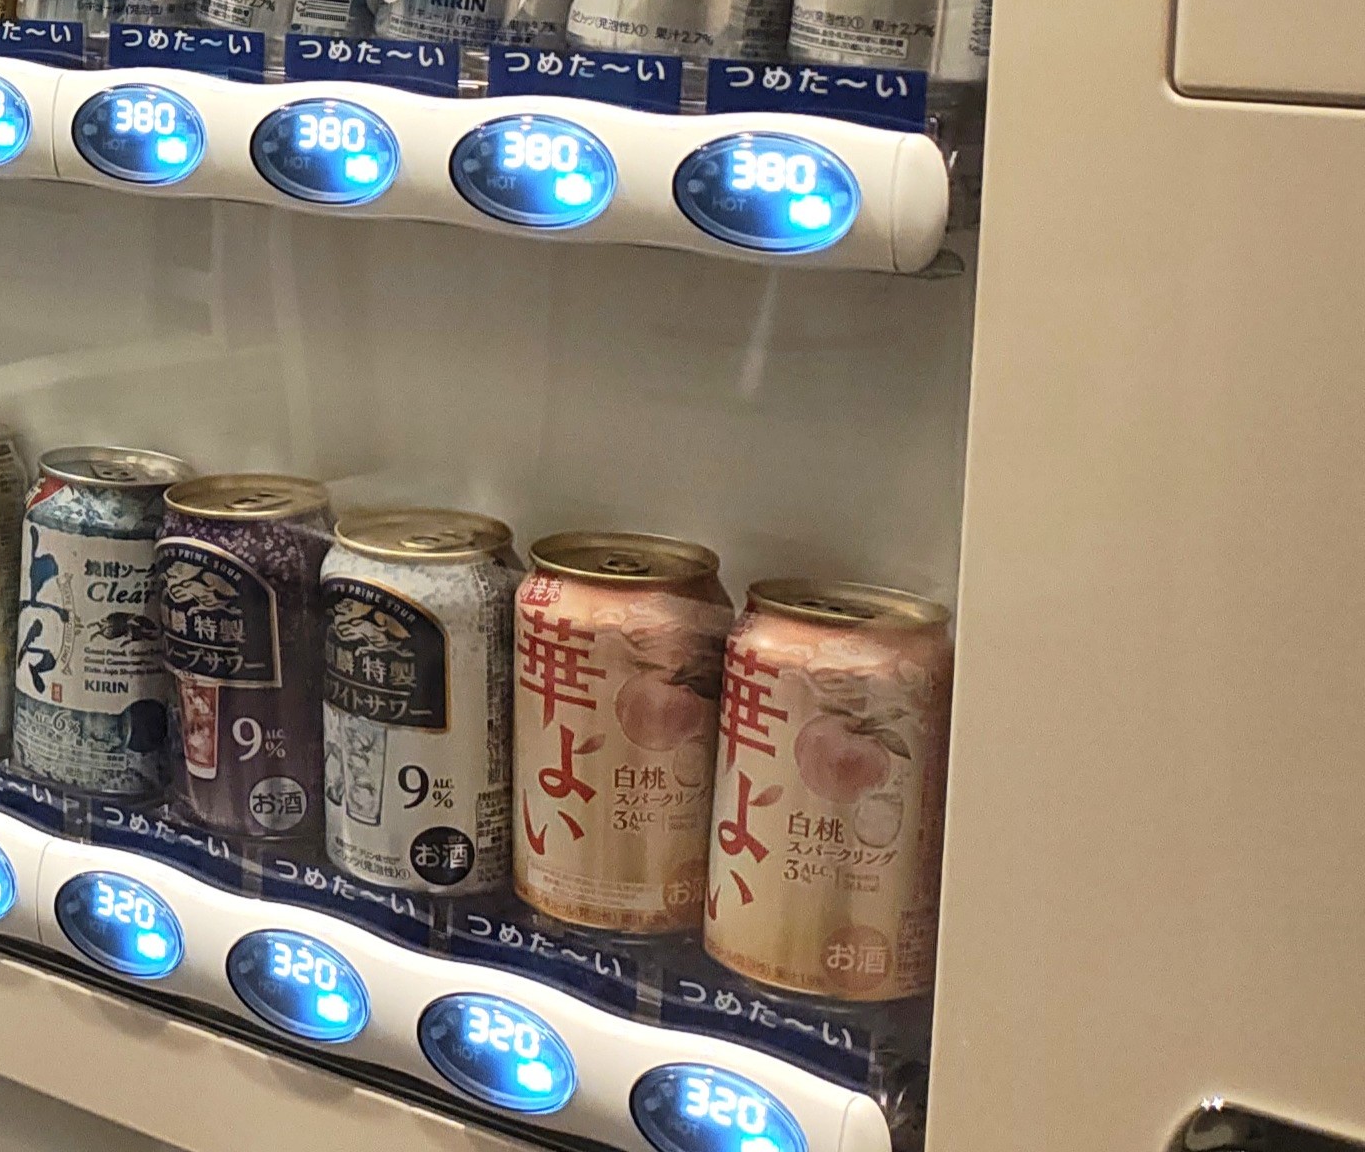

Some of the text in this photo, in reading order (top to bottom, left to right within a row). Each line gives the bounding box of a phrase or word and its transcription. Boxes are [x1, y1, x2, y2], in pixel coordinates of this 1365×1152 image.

[115, 99, 176, 134] 380
[298, 114, 366, 150] 380
[503, 131, 579, 172] 380
[730, 150, 818, 194] 380
[178, 549, 211, 567] PRIME
[87, 581, 158, 604] Clear
[347, 584, 384, 603] PRIME
[84, 678, 129, 694] KIRIN
[232, 716, 262, 762] 9
[518, 608, 607, 857] 華よい
[397, 764, 430, 810] 9
[614, 763, 667, 791] 白桃
[251, 791, 305, 816] お酒
[615, 788, 708, 809] スパークリング
[787, 812, 845, 844] 白桃
[414, 842, 471, 870] お酒
[787, 843, 899, 867] スパークリング
[95, 882, 156, 930] 320
[272, 942, 338, 991] 320
[826, 943, 889, 974] お酒
[468, 1006, 543, 1059] 320
[685, 1078, 767, 1133] 320
